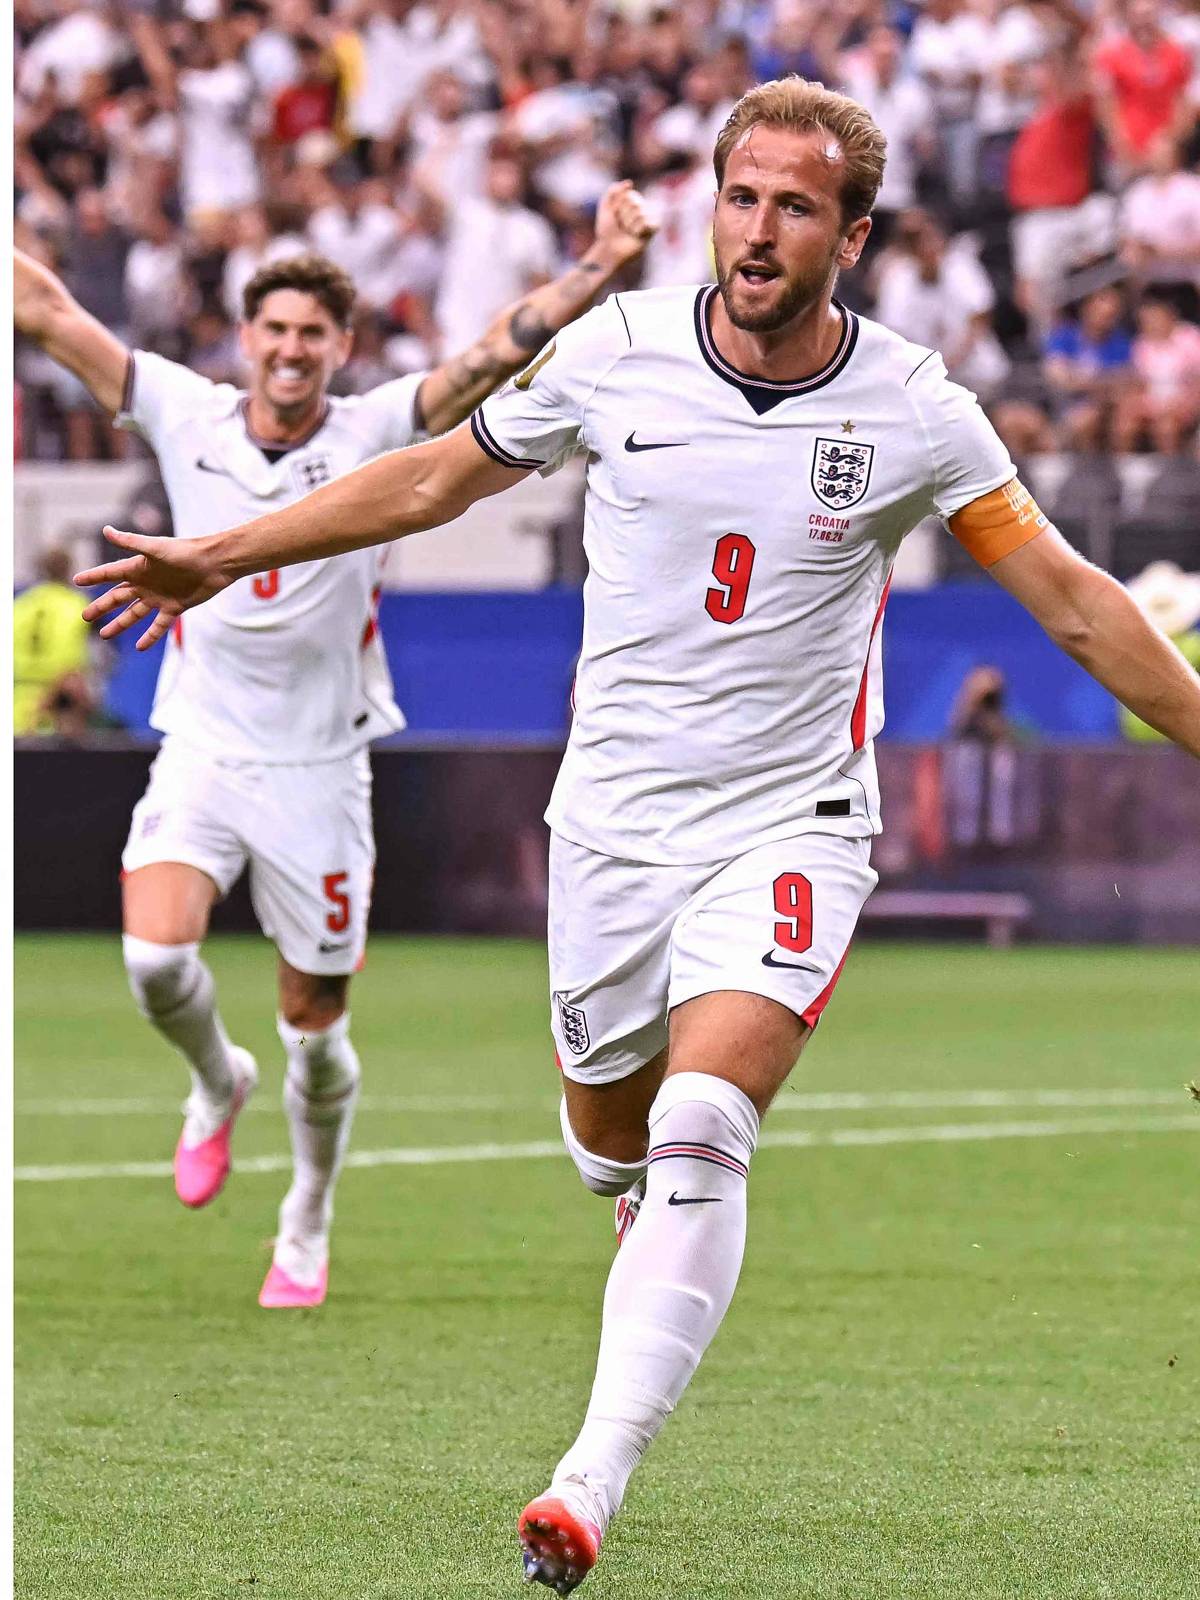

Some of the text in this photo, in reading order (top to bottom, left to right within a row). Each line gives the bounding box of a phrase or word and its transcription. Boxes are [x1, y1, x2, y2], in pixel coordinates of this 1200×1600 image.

[808, 514, 850, 530] CROATIA
[808, 528, 844, 542] 17.06.26
[704, 532, 756, 625] 9
[321, 871, 350, 933] 5
[772, 872, 813, 954] 9
